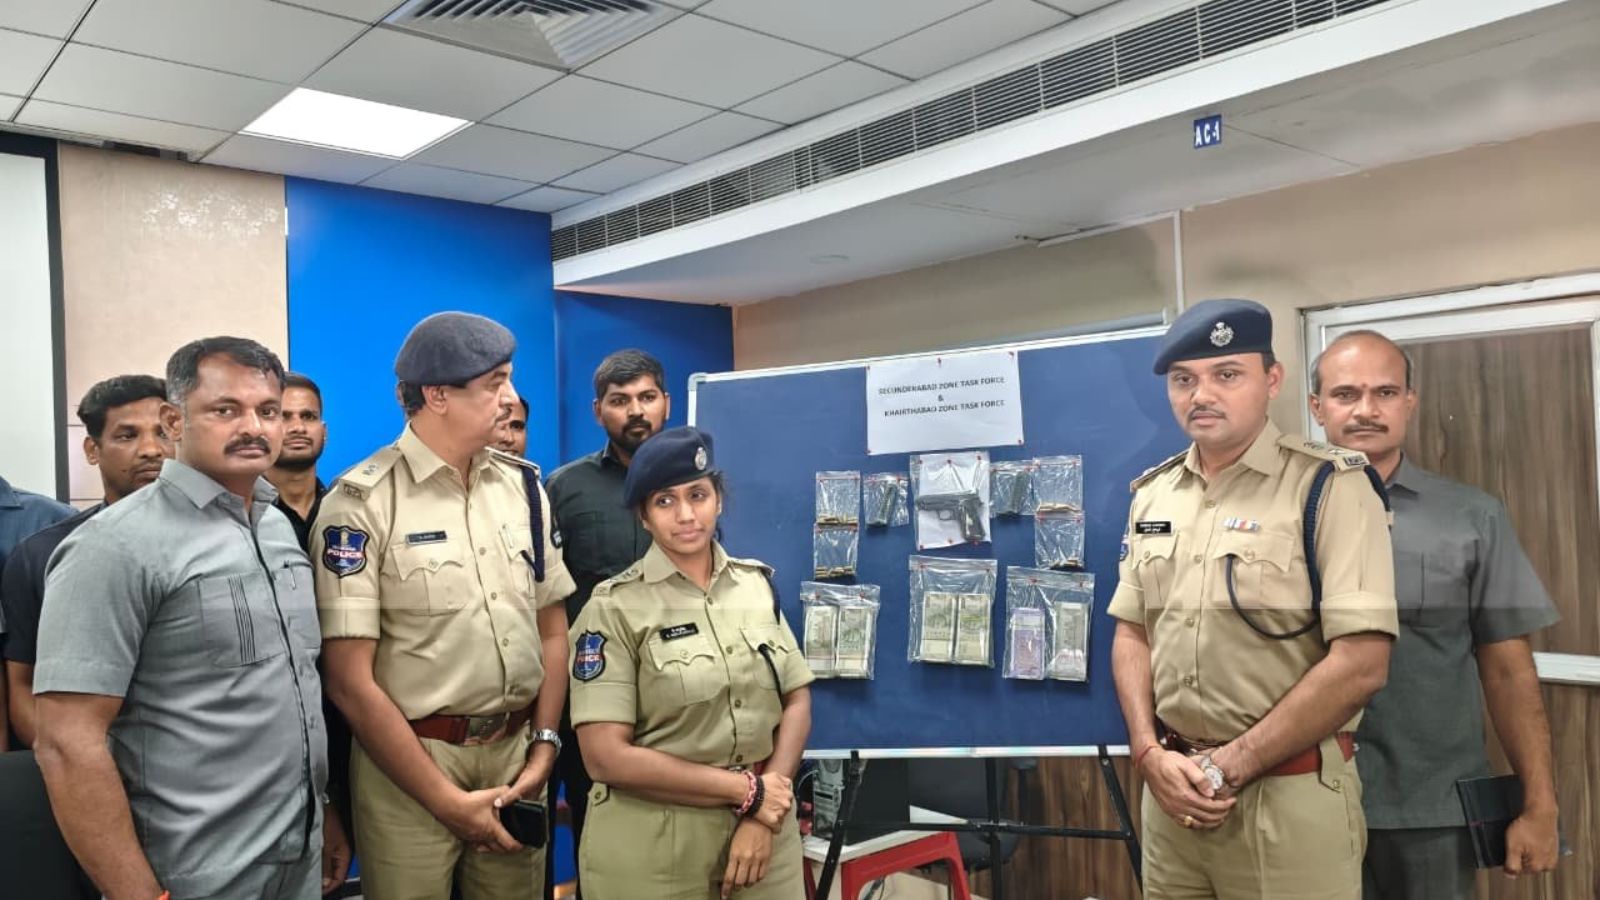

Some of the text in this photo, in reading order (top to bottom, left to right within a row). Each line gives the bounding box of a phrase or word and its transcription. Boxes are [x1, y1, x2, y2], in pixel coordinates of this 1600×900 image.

[1195, 120, 1220, 147] AC-1
[879, 376, 1005, 395] SECUNDERABAD ZONE TASK FORCE
[939, 404, 959, 413] ZONE
[960, 402, 979, 410] TASK
[980, 399, 1005, 408] FORCE
[327, 548, 363, 559] POLICE
